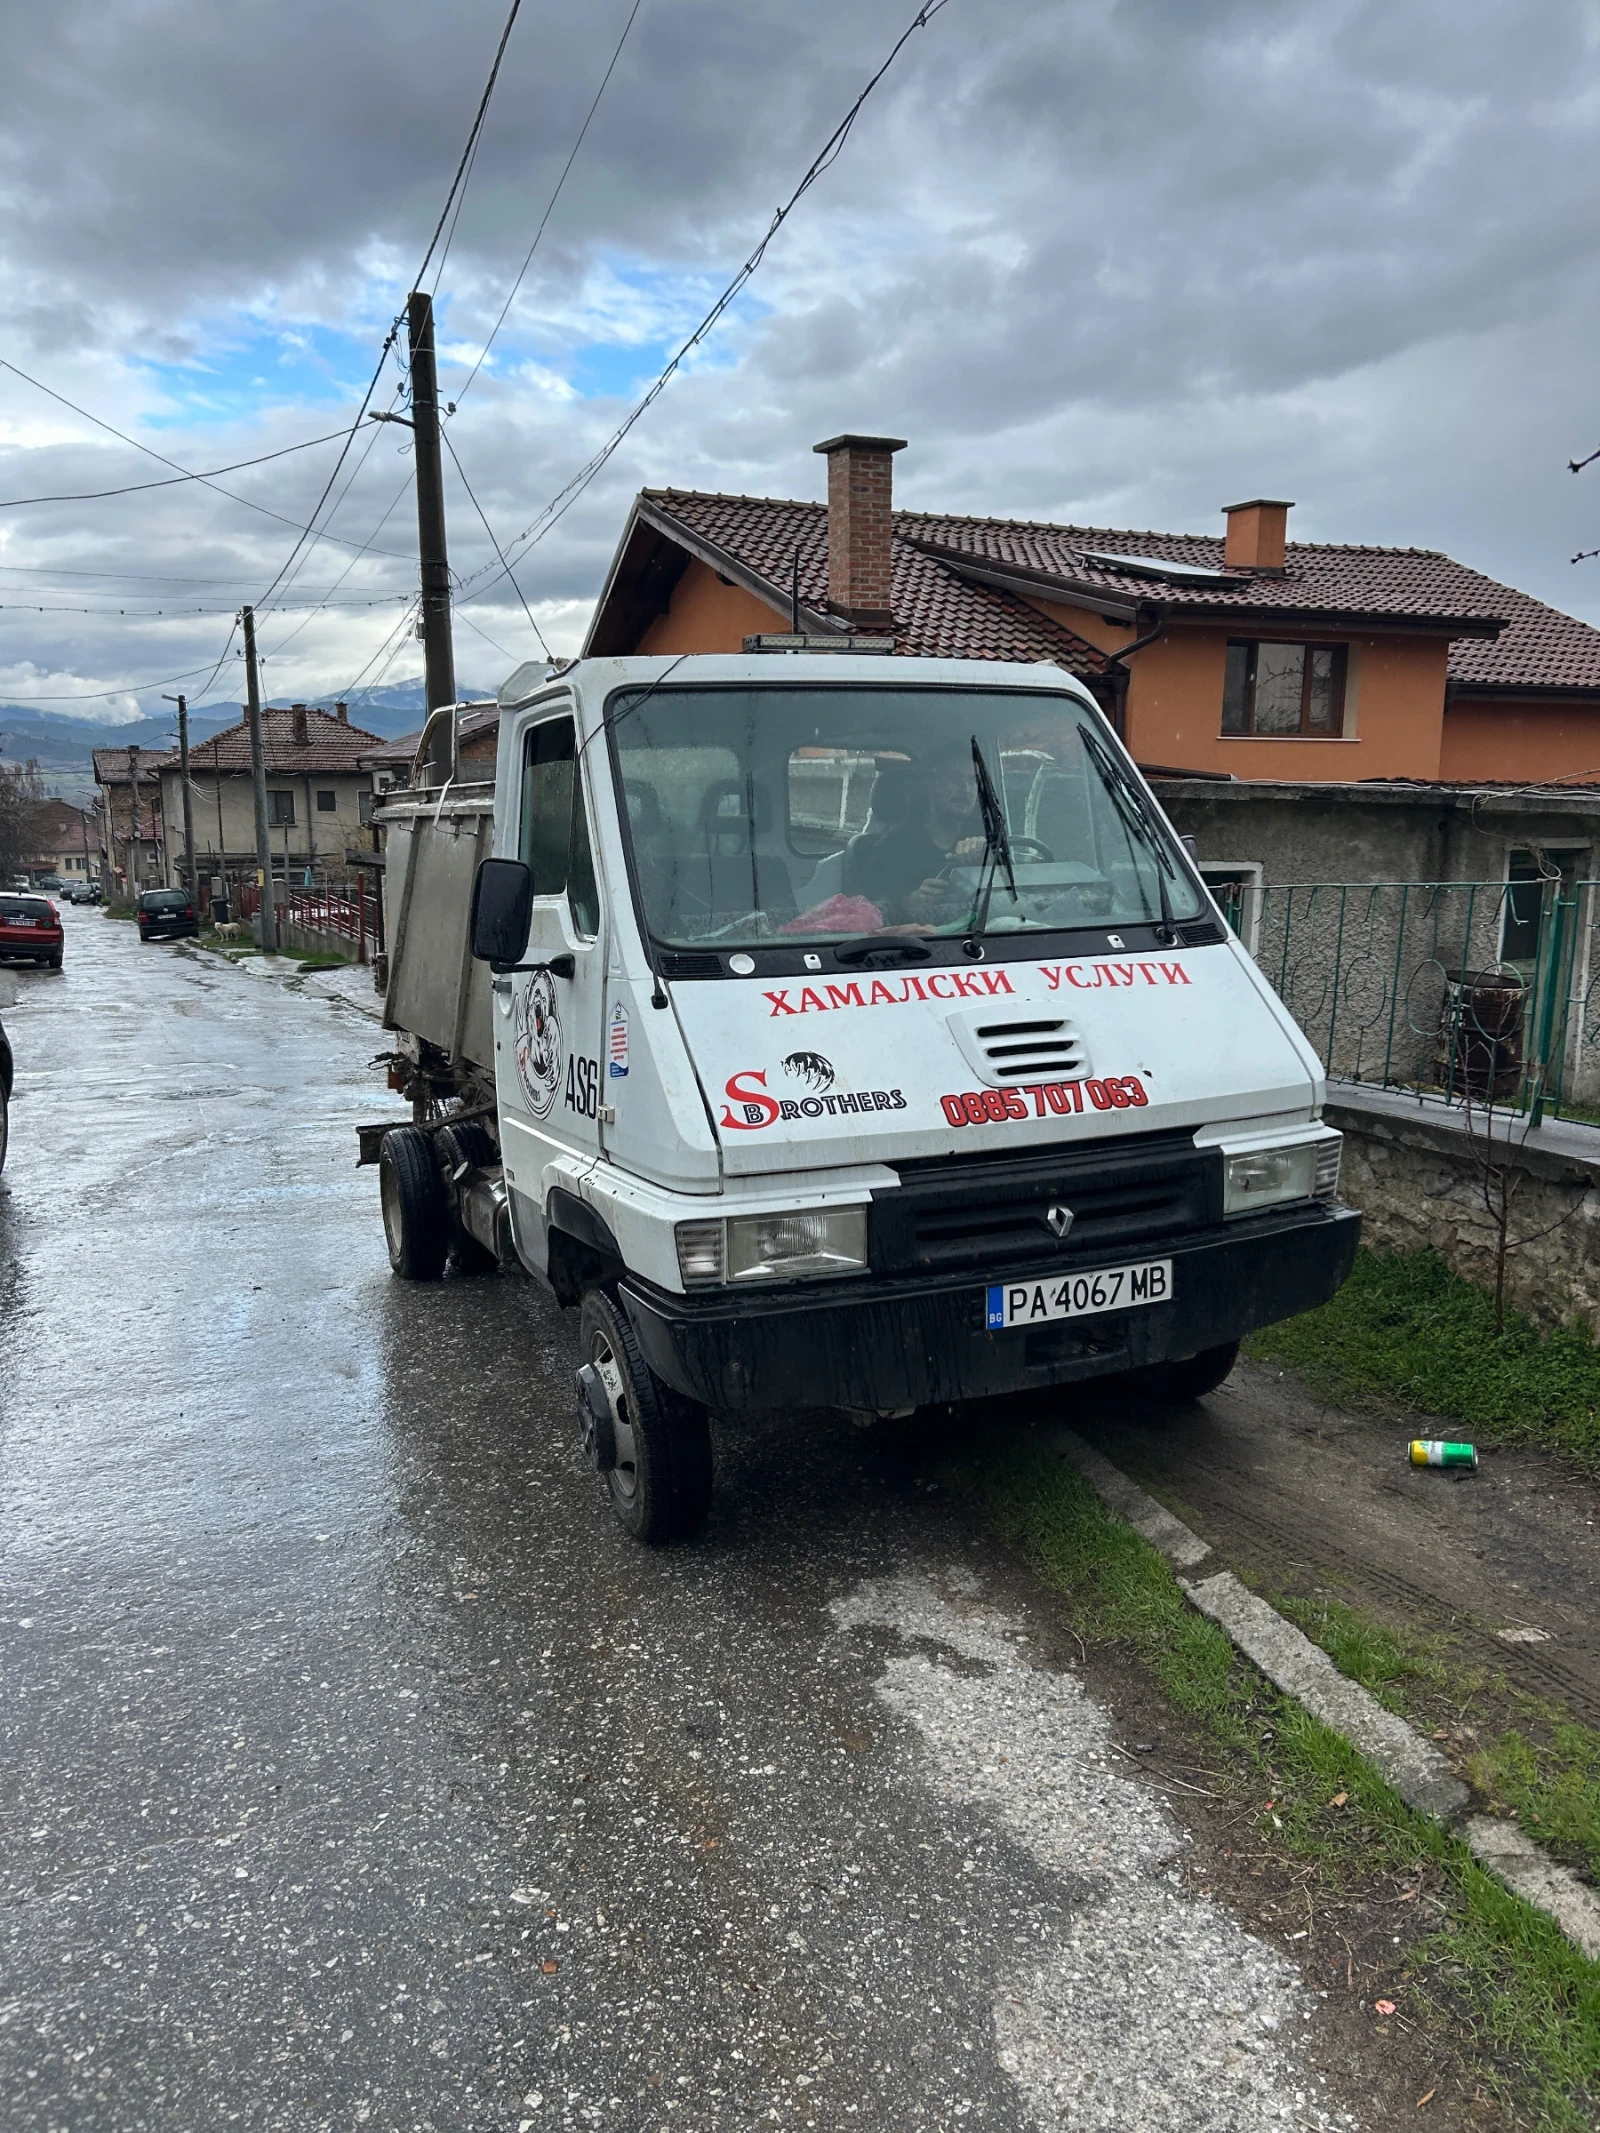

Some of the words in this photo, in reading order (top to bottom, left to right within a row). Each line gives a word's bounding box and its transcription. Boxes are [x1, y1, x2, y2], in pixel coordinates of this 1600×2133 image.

[761, 969, 1016, 1018] ХАМАЛСКИ
[1037, 961, 1193, 991] УСЛУГИ
[939, 1087, 1029, 1128] 0885
[1023, 1080, 1085, 1118] 707
[1085, 1075, 1149, 1111] 063
[989, 1313, 1003, 1324] BG
